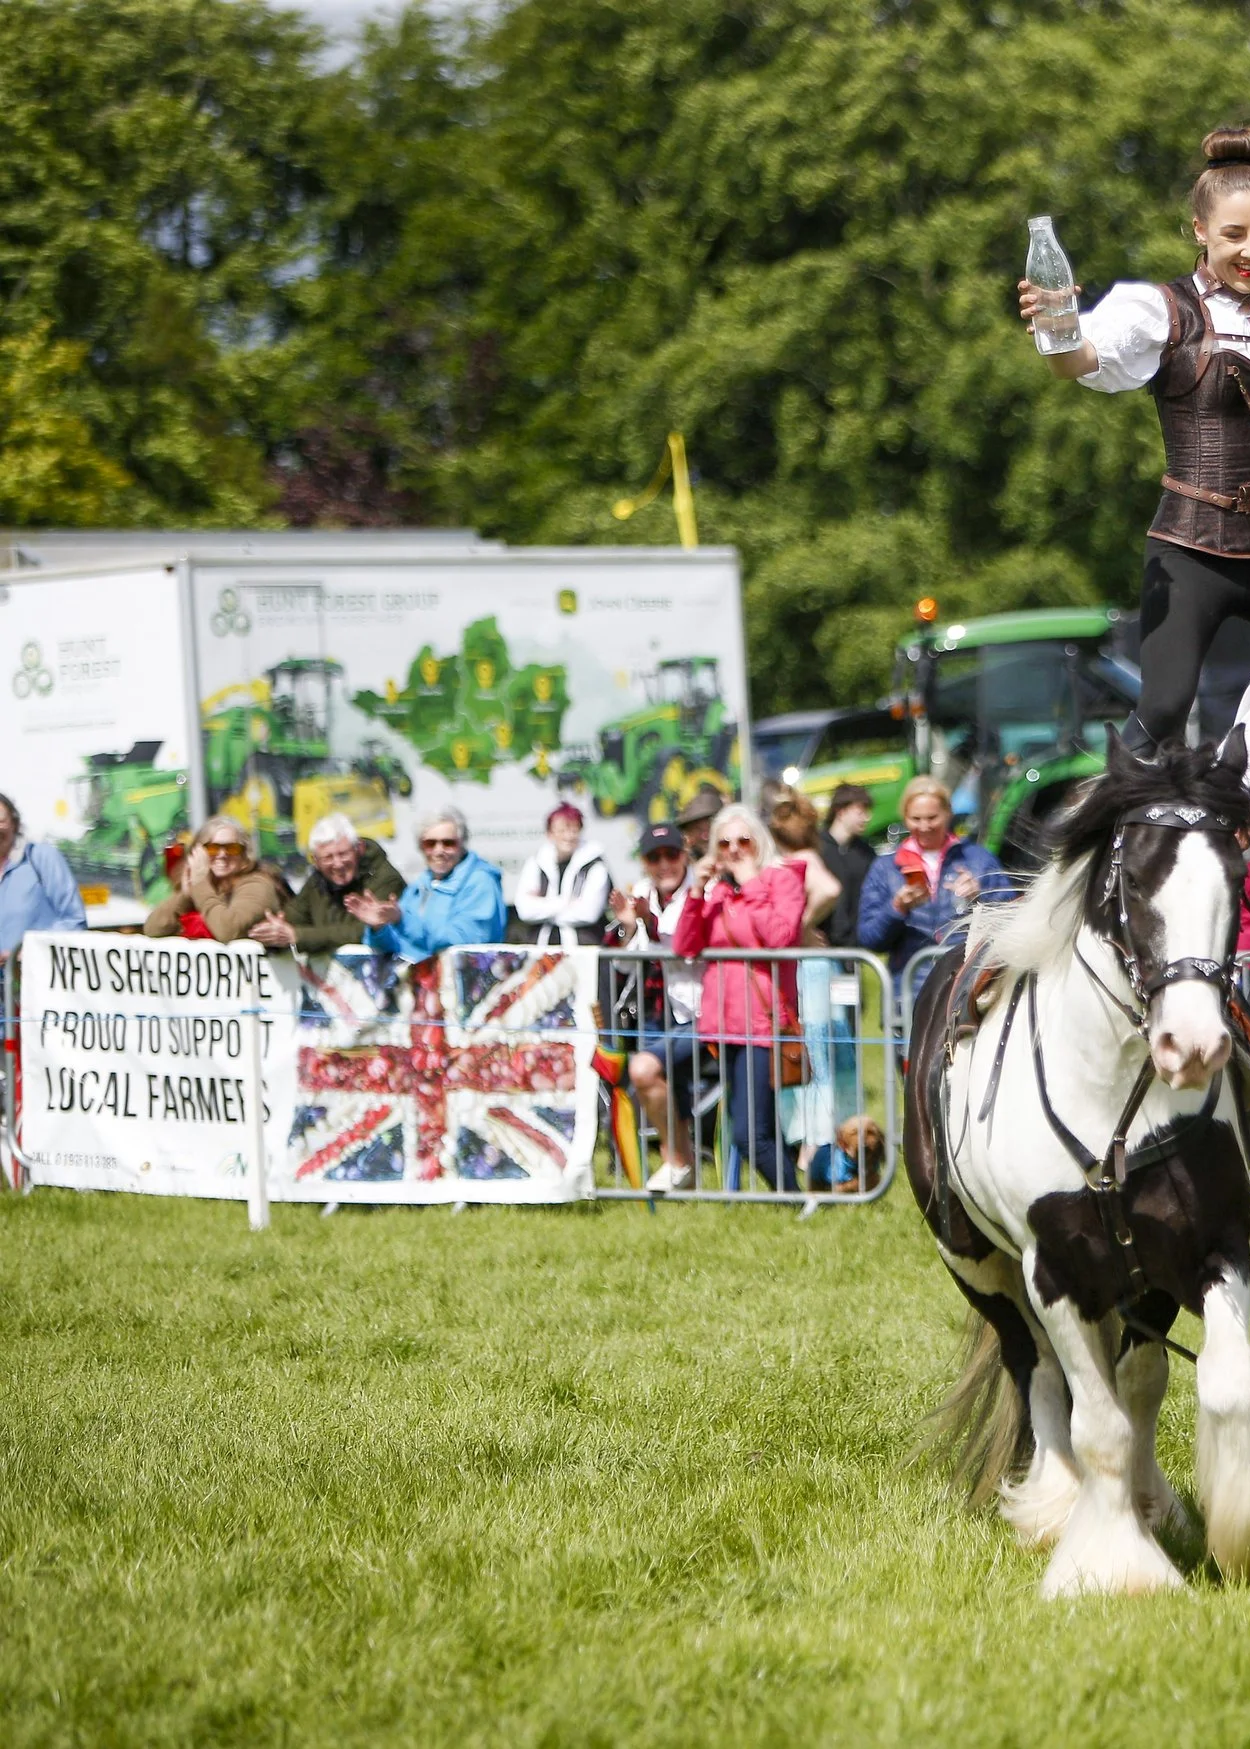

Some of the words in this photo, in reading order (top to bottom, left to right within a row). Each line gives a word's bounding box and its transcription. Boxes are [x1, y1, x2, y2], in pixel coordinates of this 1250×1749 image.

[49, 944, 102, 993] NFU
[106, 947, 272, 999] SHERBORNE
[40, 1009, 128, 1052] PROUD
[135, 1013, 162, 1054] TO
[167, 1015, 275, 1059] SUPPOT
[45, 1066, 137, 1118] LOCAL
